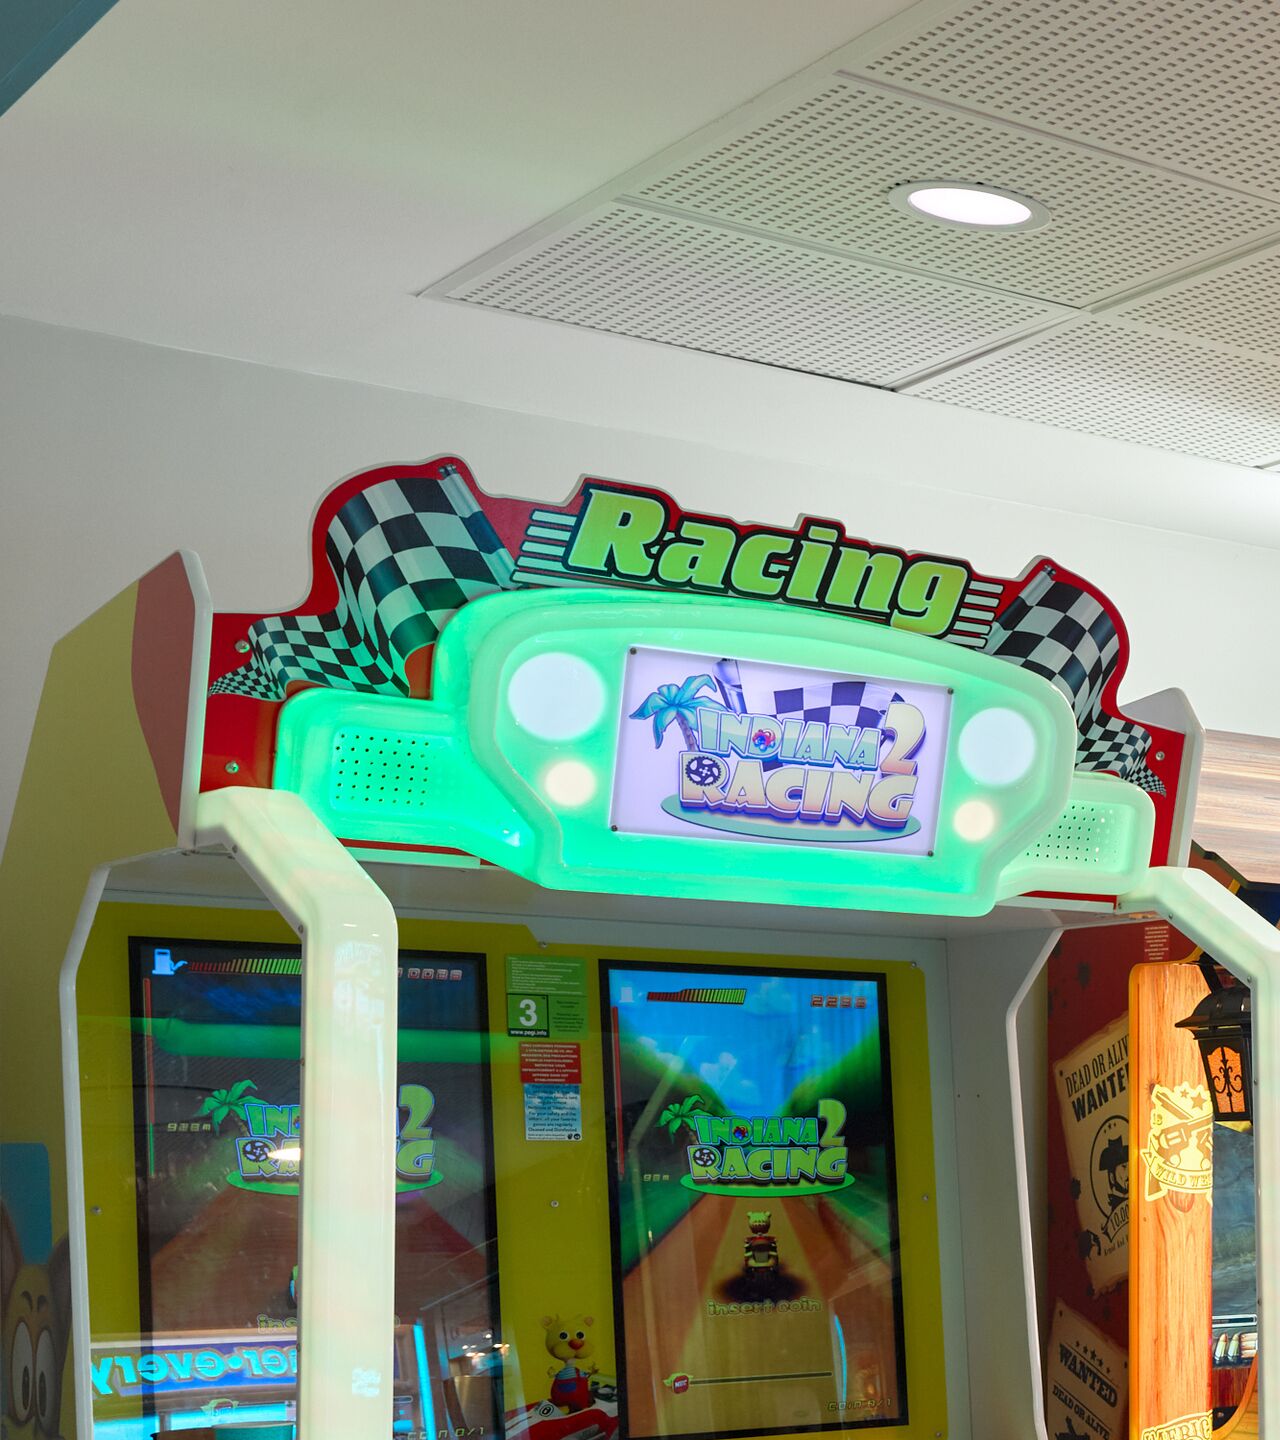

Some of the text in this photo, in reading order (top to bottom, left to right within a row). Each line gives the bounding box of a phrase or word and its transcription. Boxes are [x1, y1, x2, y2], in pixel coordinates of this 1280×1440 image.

[566, 486, 971, 637] Racing
[697, 702, 926, 775] INDIANA 2
[679, 750, 919, 829] RACING
[510, 1029, 547, 1037] www.pegi.info
[519, 999, 538, 1027] 3
[1065, 1033, 1129, 1098] DEAD OR ALIV
[397, 1084, 435, 1139] 2
[1071, 1063, 1129, 1122] WANTE
[693, 1099, 847, 1147] INDIANA 2
[687, 1145, 849, 1182] RACING
[1155, 1164, 1186, 1188] WILD
[705, 1296, 823, 1317] insert coin
[1059, 1343, 1118, 1408] WANTED
[1052, 1384, 1074, 1410] DEAD
[1074, 1404, 1086, 1421] OR
